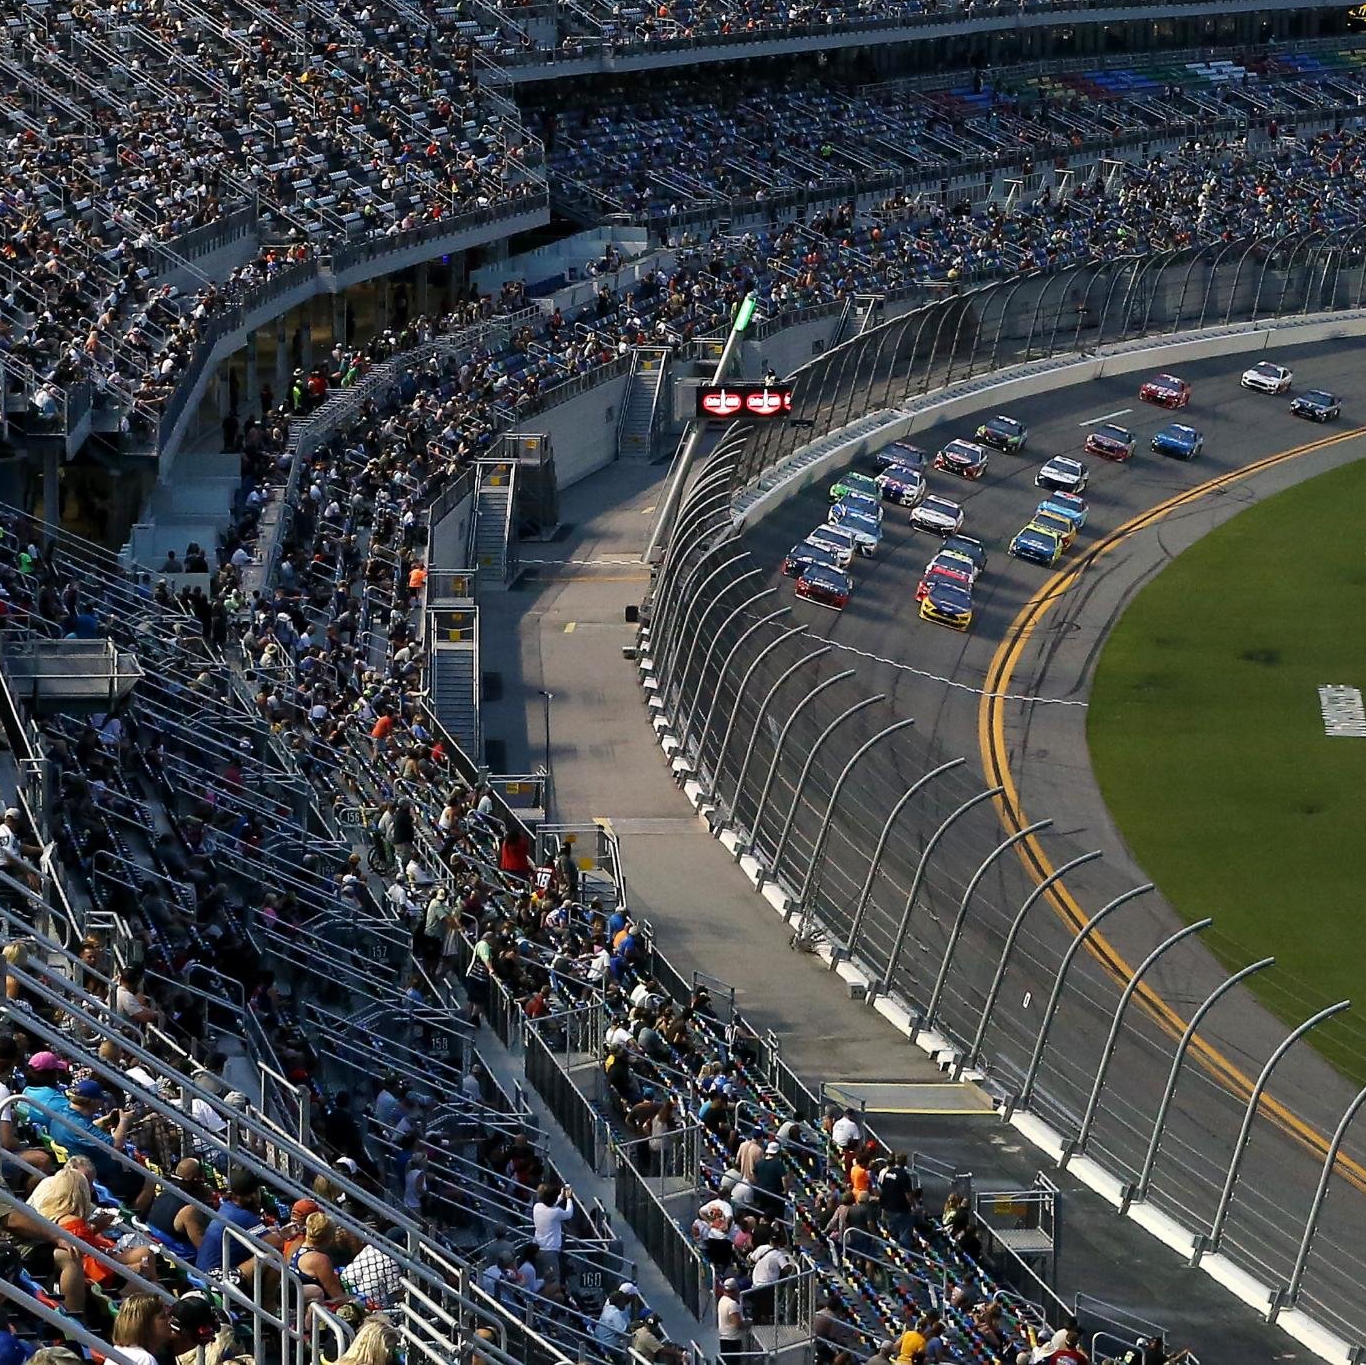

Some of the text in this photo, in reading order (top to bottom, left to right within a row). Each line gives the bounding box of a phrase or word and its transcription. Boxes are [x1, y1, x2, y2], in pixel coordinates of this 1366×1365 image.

[346, 812, 360, 823] 156
[372, 946, 388, 958] 157
[582, 1272, 602, 1287] 160
